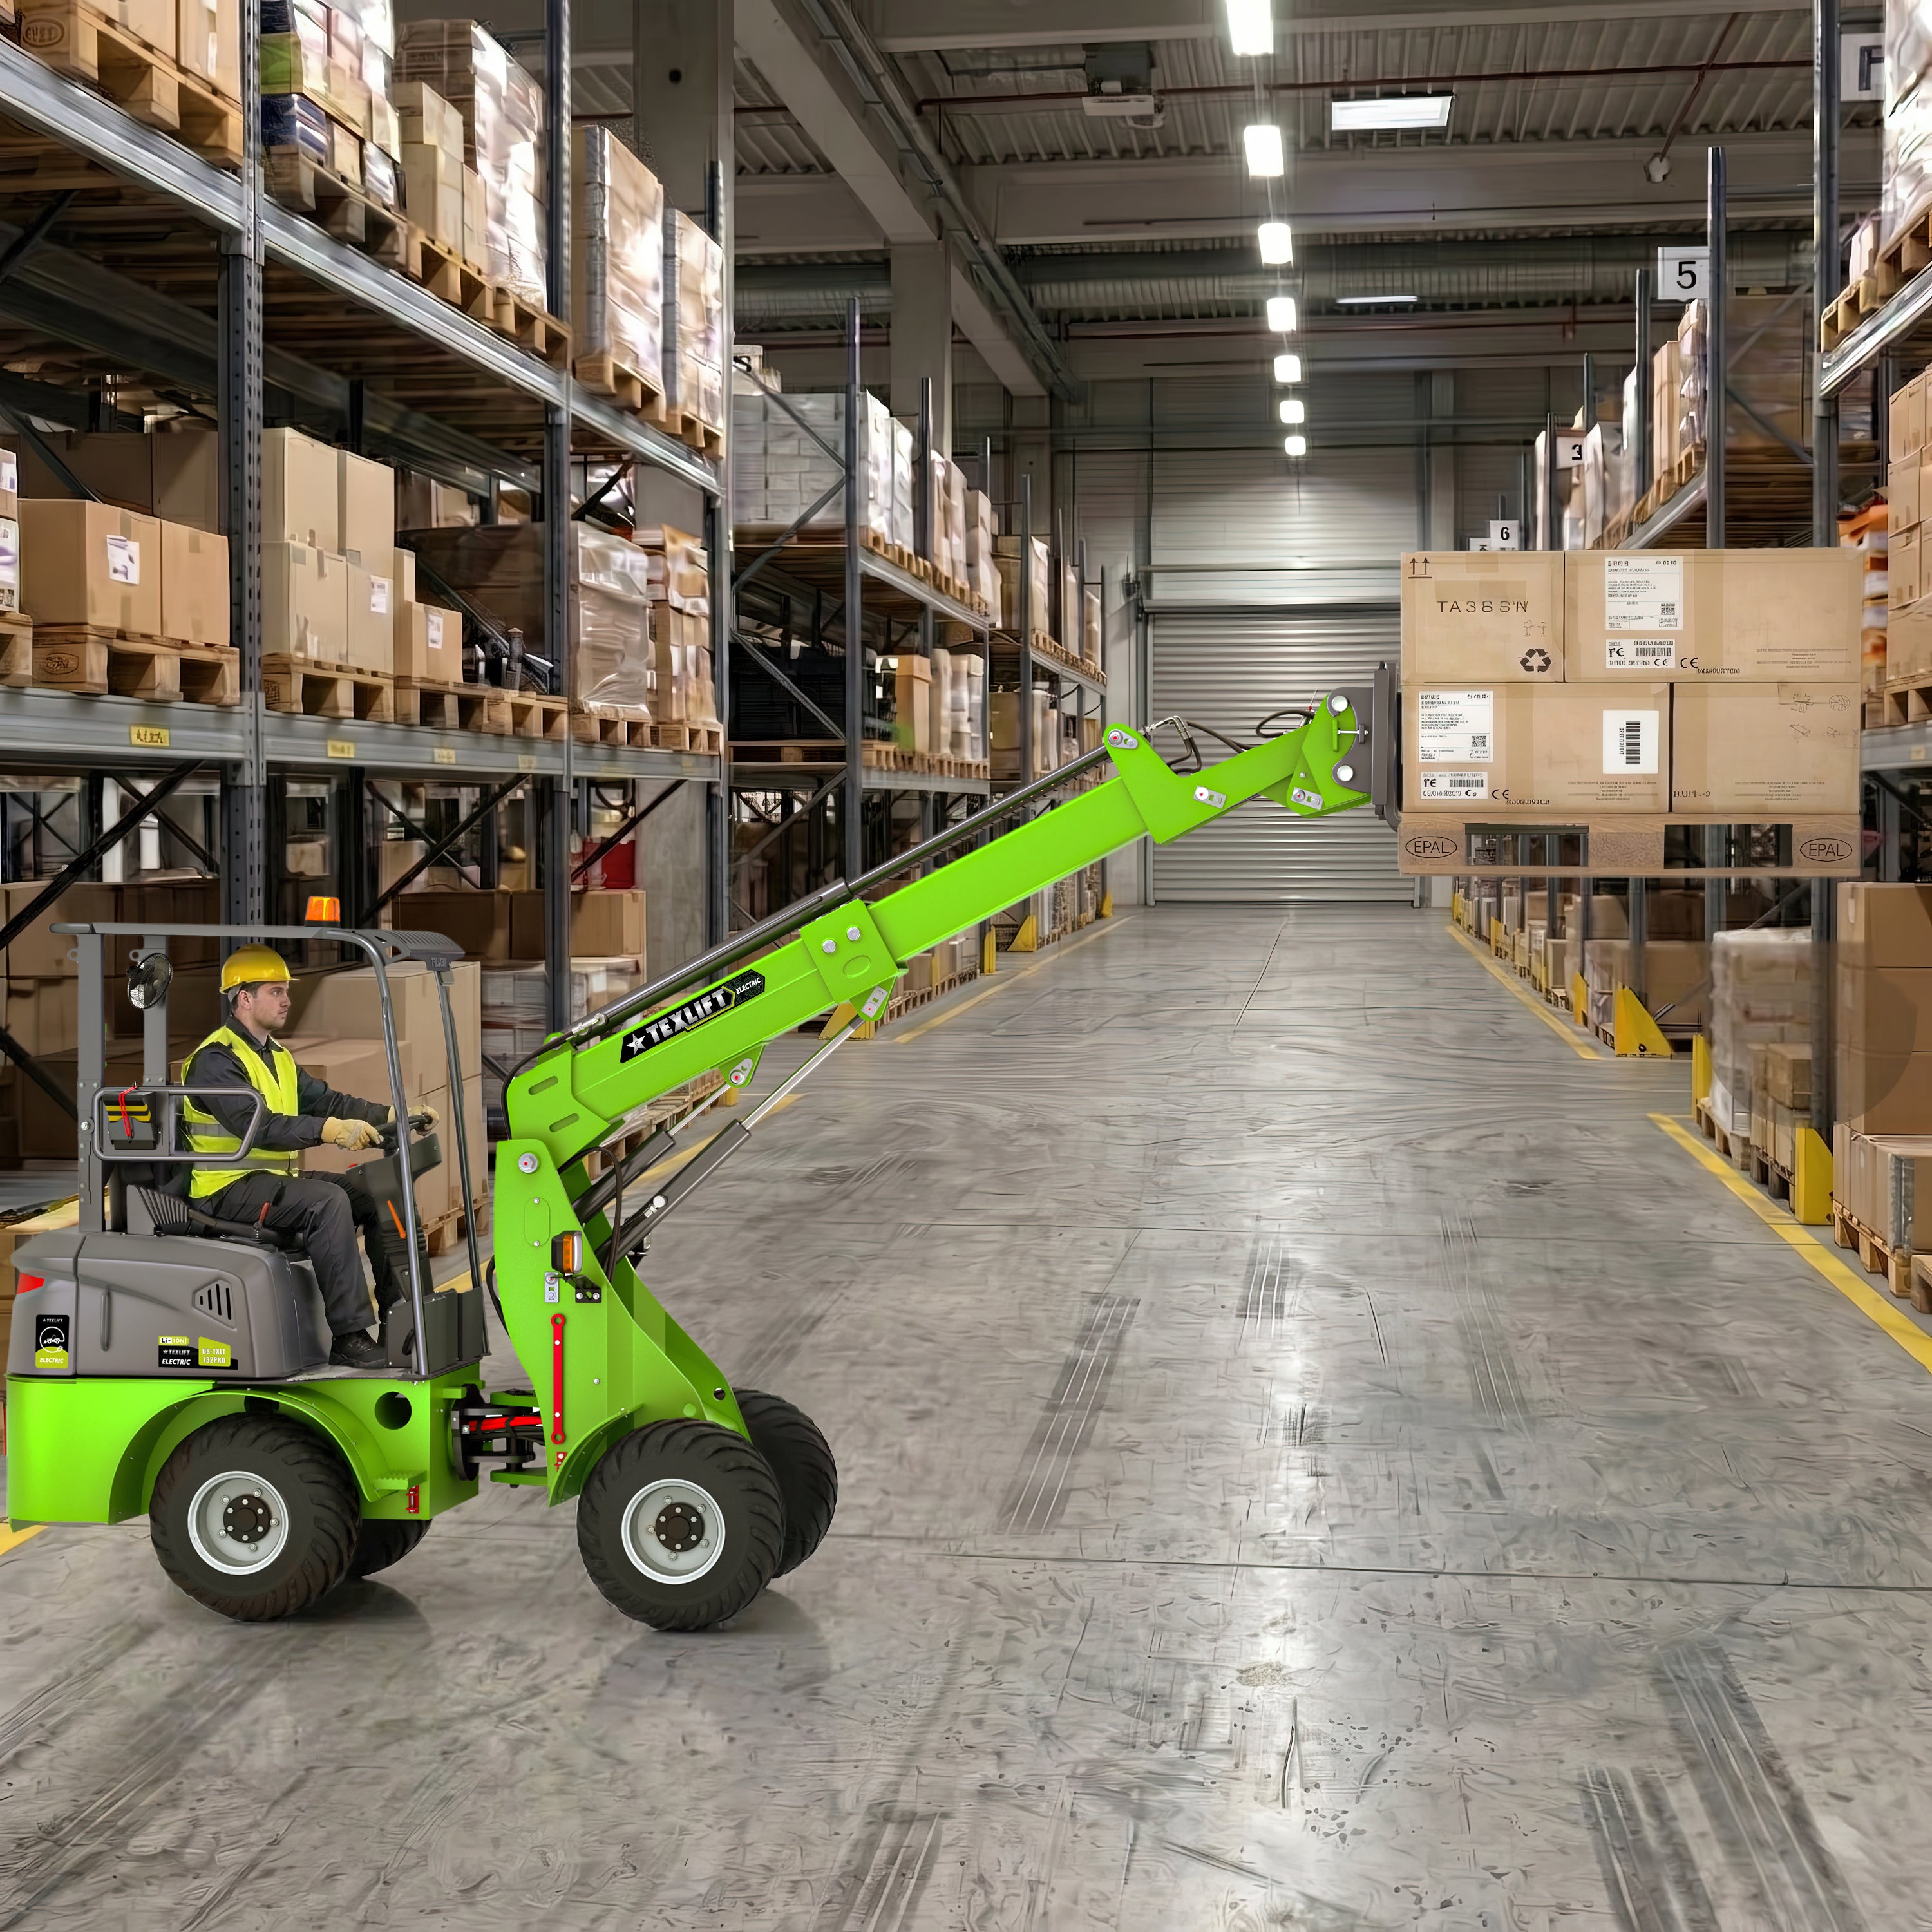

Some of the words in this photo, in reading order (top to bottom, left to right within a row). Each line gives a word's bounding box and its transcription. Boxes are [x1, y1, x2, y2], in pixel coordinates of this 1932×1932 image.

[1676, 261, 1697, 289] 5
[1501, 527, 1510, 540] 6
[1414, 840, 1450, 853] EPAL
[1809, 843, 1845, 857] EPAL
[645, 988, 726, 1043] TEXLIFT
[736, 977, 761, 995] ELECTRIC
